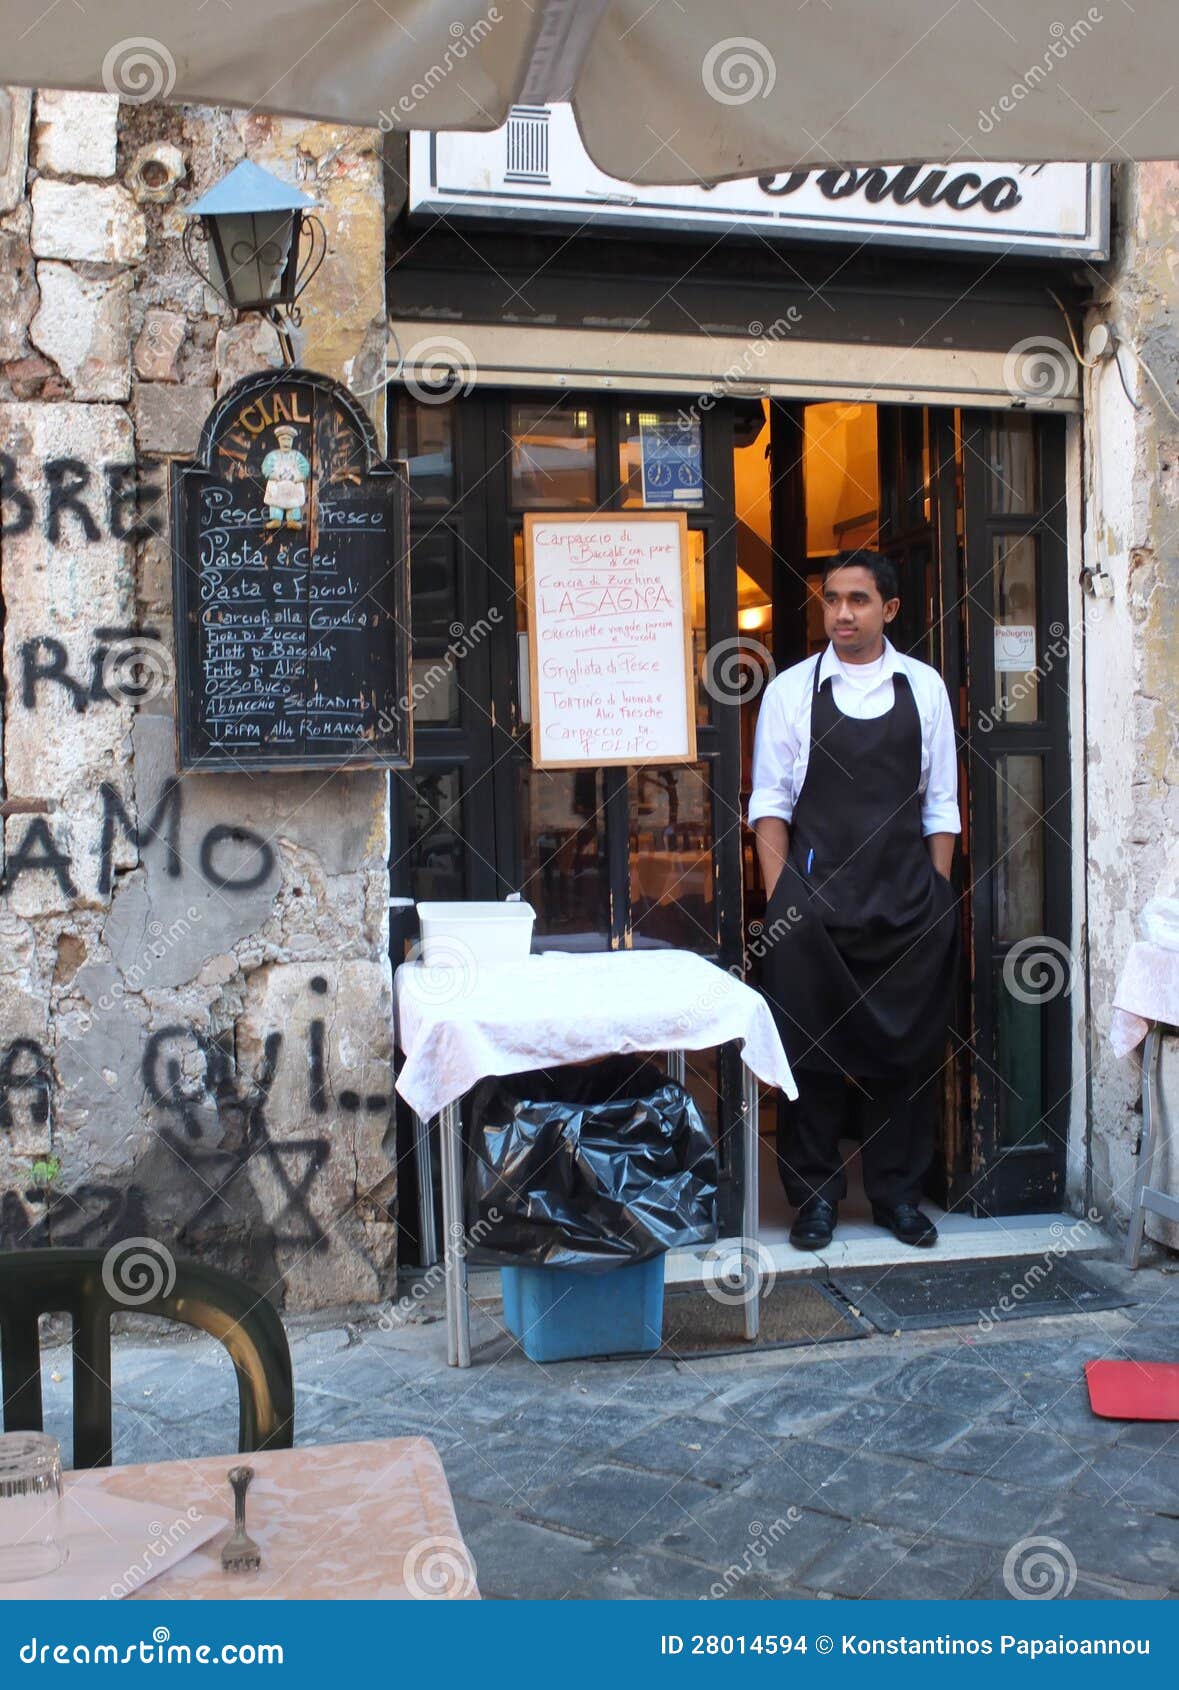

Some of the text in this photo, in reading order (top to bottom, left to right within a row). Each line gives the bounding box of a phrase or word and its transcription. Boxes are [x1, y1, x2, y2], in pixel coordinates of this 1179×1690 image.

[318, 502, 384, 525] Fresco
[200, 529, 267, 567] Pasta
[294, 547, 336, 567] Ceci
[536, 530, 632, 553] Carpaccio di
[200, 570, 262, 600] Pasta
[272, 580, 284, 595] e
[541, 585, 674, 616] LASAGNA
[275, 607, 303, 625] alla
[542, 657, 603, 684] Grigliata
[606, 659, 617, 673] di
